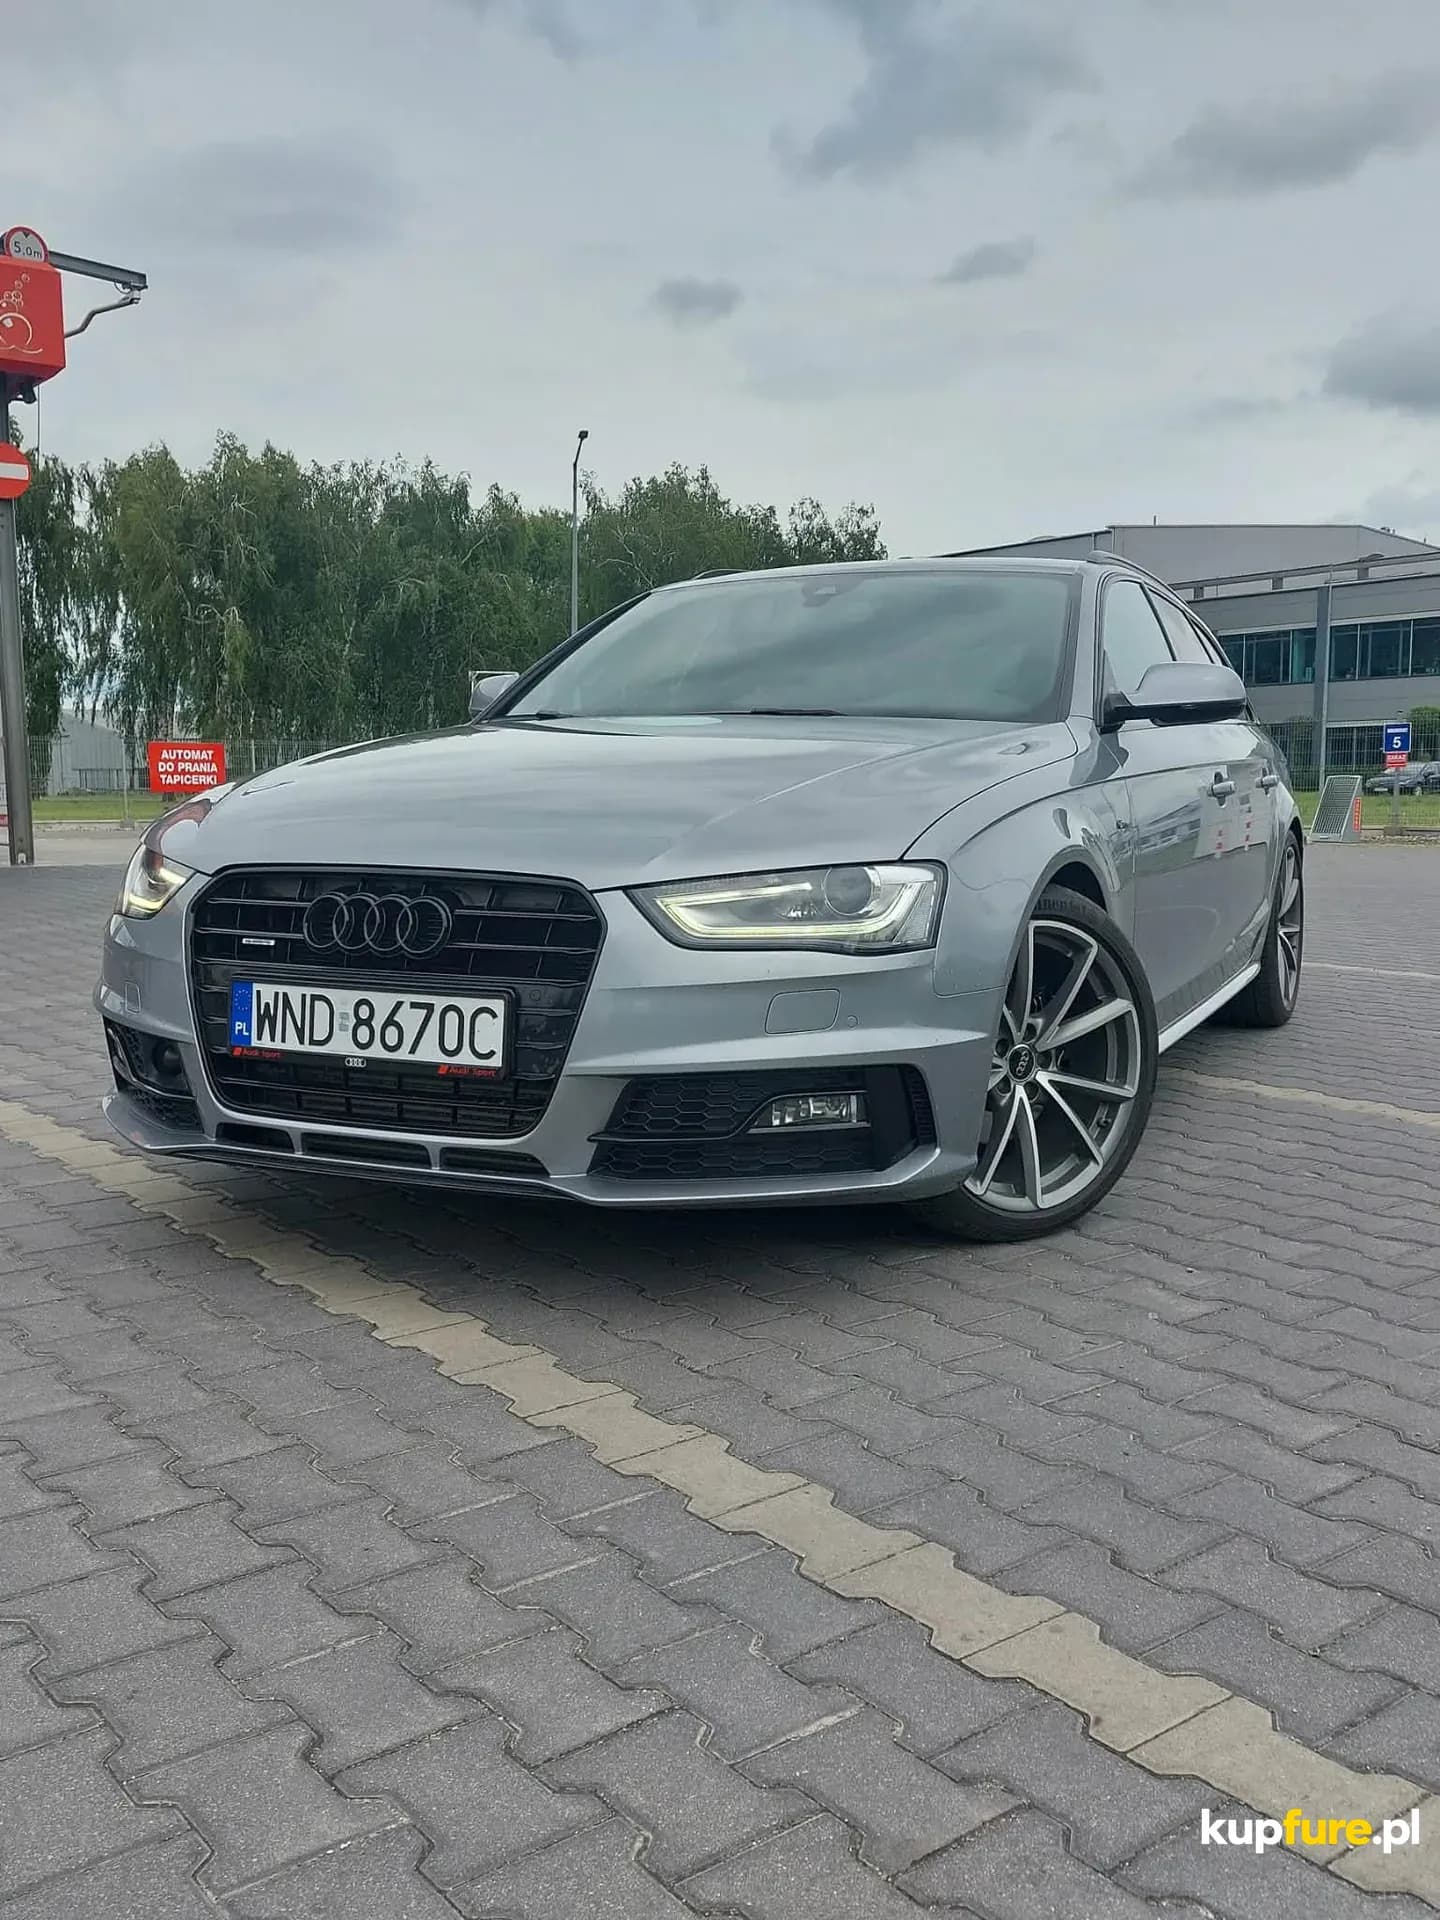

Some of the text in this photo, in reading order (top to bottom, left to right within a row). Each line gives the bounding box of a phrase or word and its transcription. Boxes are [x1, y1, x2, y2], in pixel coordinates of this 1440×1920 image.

[1392, 736, 1402, 748] 5
[162, 750, 214, 760] AUTOMAT
[158, 762, 218, 773] DO PRANIA
[160, 775, 217, 785] TAPICERKI
[234, 1021, 249, 1036] PL
[255, 989, 499, 1061] WND 8670C
[449, 1064, 470, 1074] Audi
